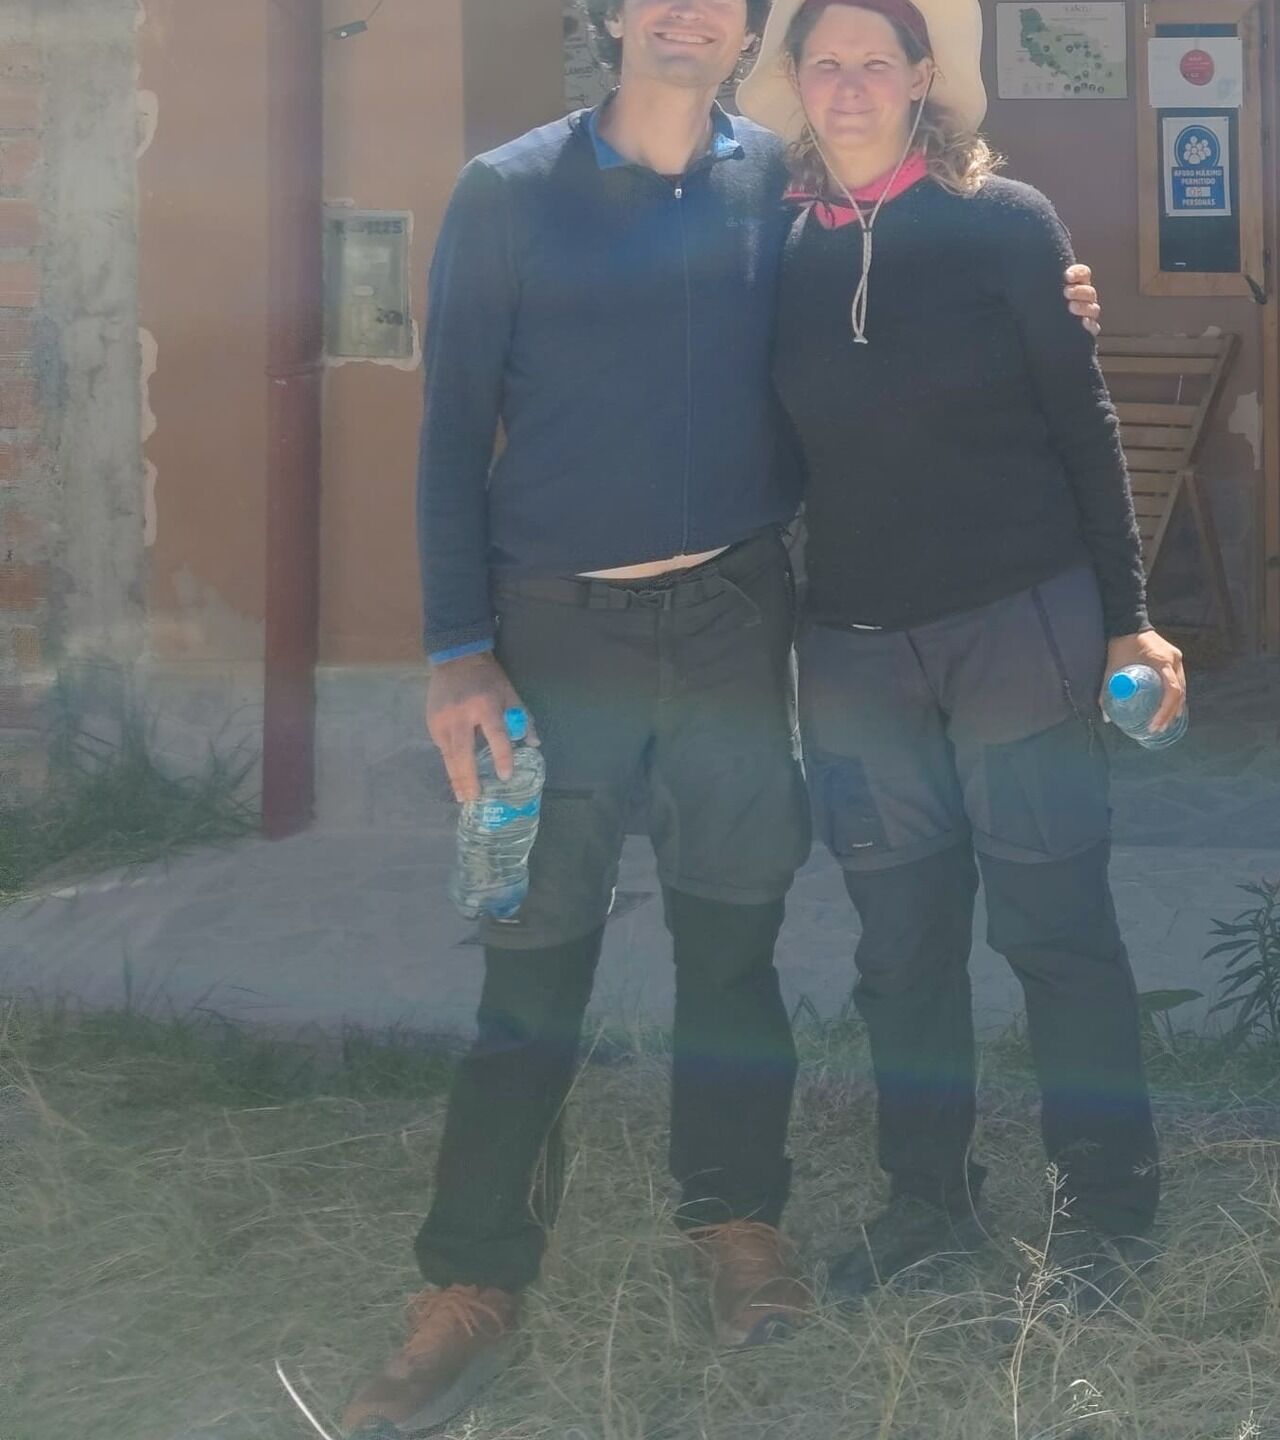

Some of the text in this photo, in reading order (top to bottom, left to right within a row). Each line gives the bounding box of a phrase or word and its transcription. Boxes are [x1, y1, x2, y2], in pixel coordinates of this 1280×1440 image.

[1173, 169, 1194, 177] AFORO
[1180, 177, 1216, 185] PERMITIDO
[1182, 198, 1216, 206] PERSONAS
